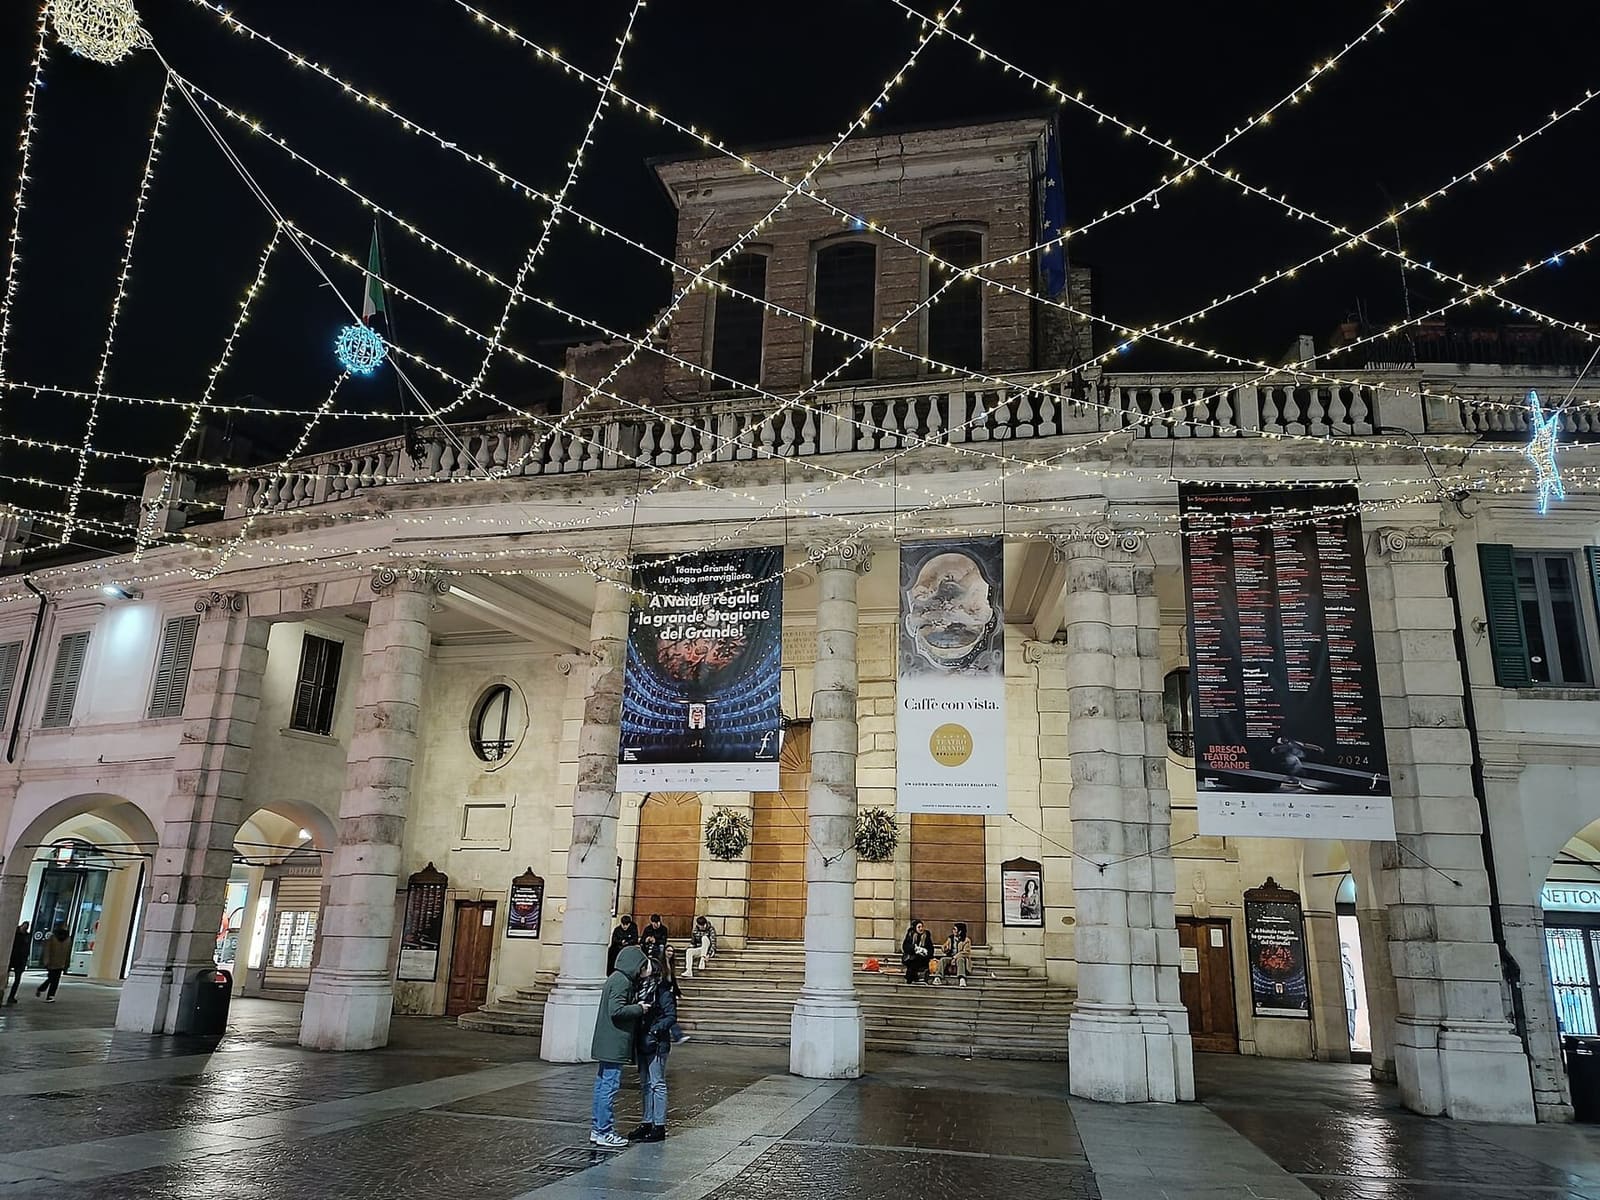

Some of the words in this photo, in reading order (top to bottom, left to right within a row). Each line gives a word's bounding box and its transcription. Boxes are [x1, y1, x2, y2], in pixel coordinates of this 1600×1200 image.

[675, 565, 702, 574] Teatro
[703, 563, 737, 573] Grande.
[658, 576, 670, 584] Un
[671, 575, 696, 584] luogo
[697, 572, 754, 584] meraviglioso.
[649, 595, 661, 608] A
[663, 592, 711, 608] Natale
[713, 590, 760, 608] regala
[638, 611, 653, 625] la
[653, 610, 704, 627] grande
[706, 607, 771, 624] Stagione
[660, 626, 683, 640] del
[685, 624, 744, 640] Grande!
[904, 697, 938, 710] Caffè
[941, 700, 964, 710] con
[966, 697, 1000, 710] vista.
[1209, 745, 1247, 754] BRESCIA
[1203, 752, 1238, 762] TEATRO
[1337, 755, 1369, 765] 2024
[1210, 760, 1250, 770] GRANDE
